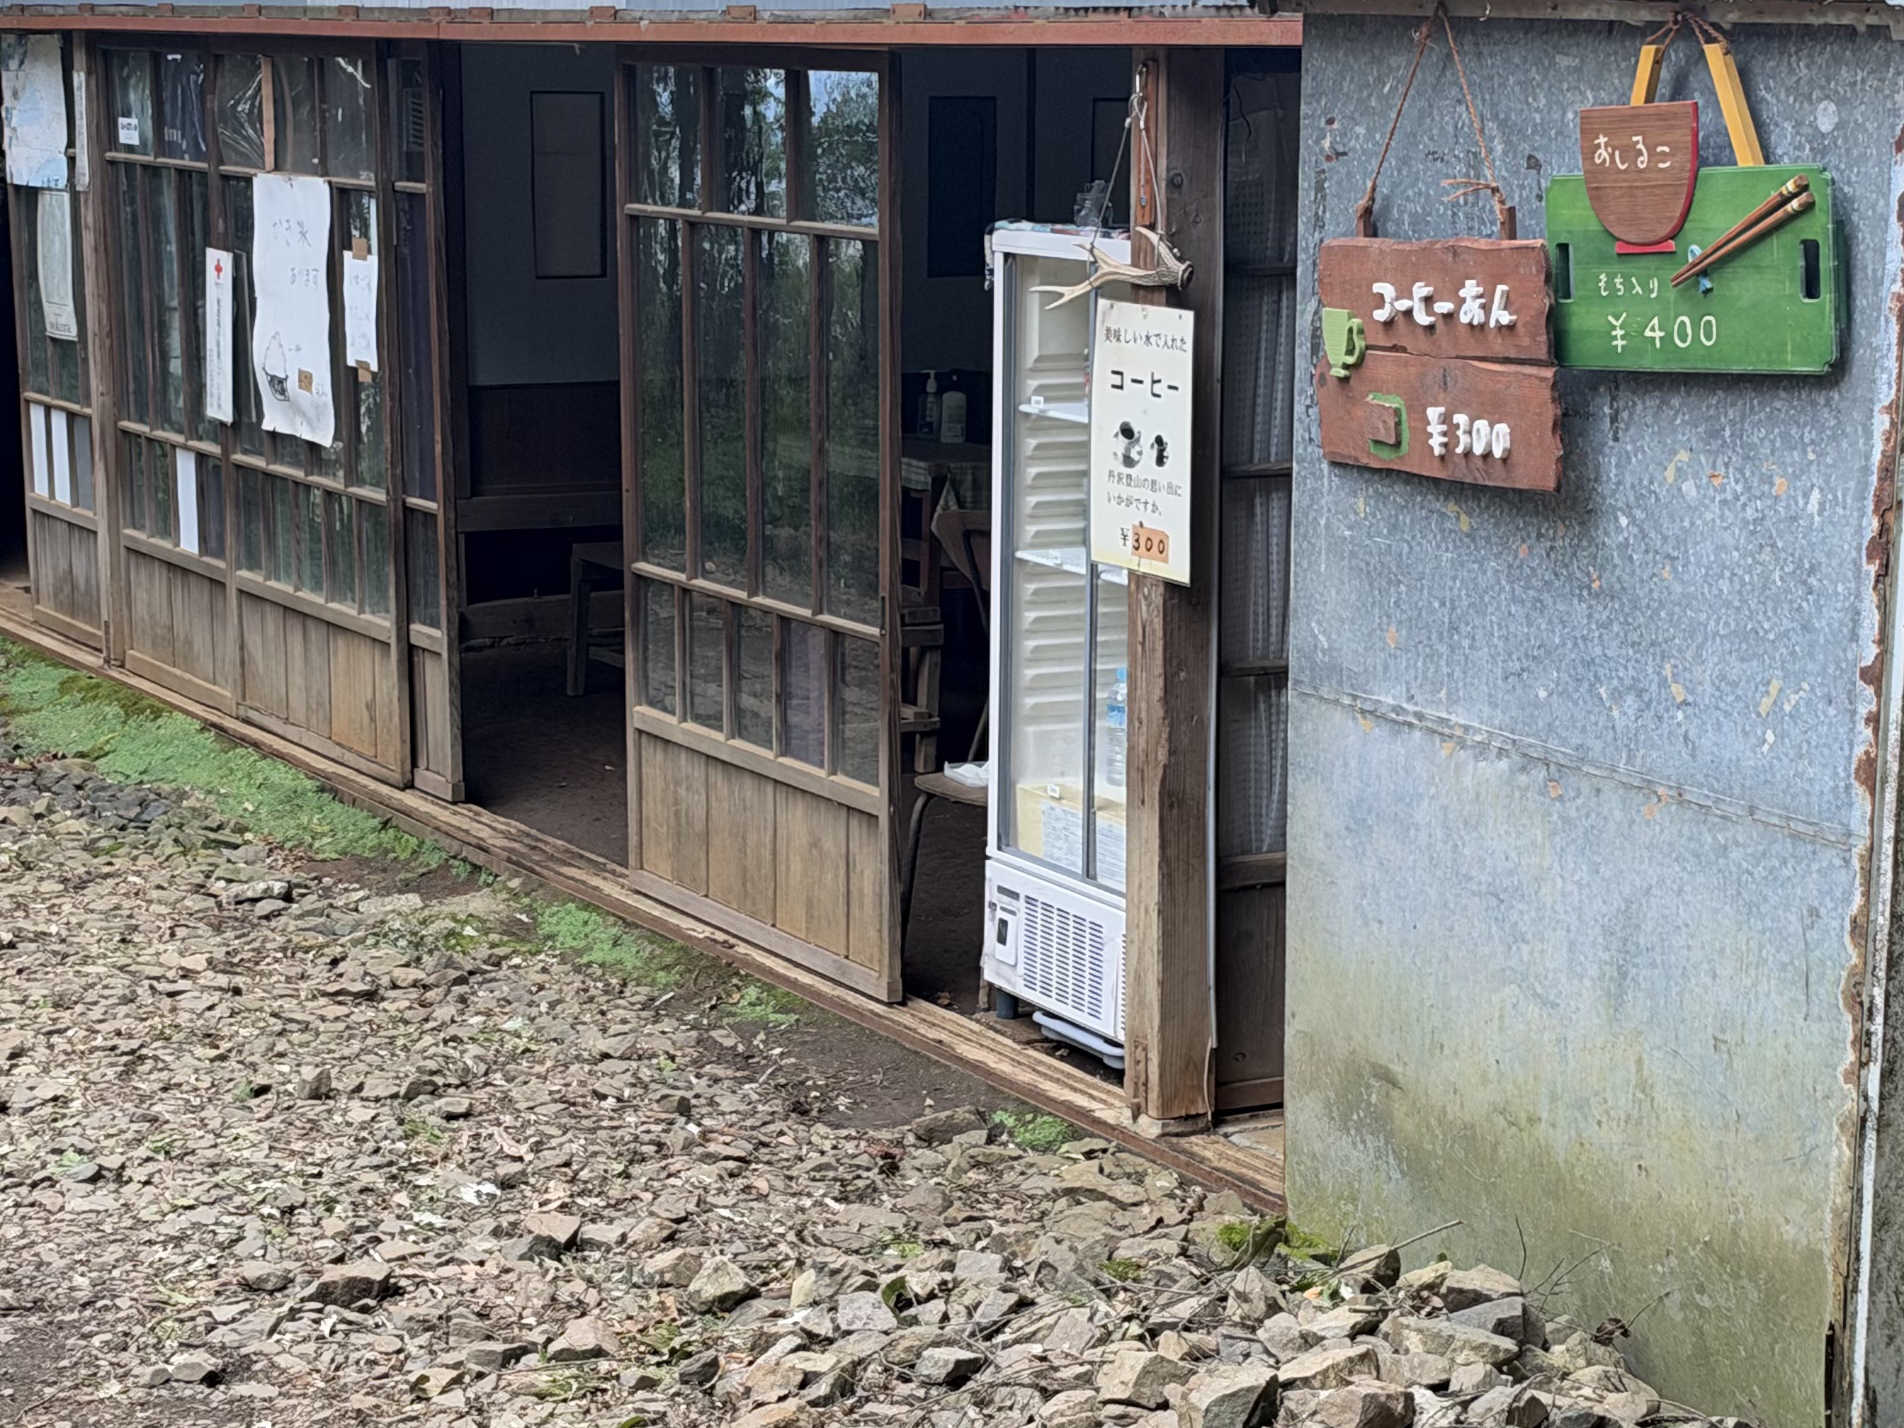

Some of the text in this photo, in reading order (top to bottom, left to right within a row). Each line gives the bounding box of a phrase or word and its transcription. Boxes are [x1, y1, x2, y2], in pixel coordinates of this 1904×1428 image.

[1594, 133, 1672, 170] おしるこ
[1598, 273, 1659, 299] もち入り
[1103, 325, 1188, 353] 美味しい水で入れた
[1607, 312, 1717, 353] ¥400
[1110, 369, 1180, 399] コーヒー
[1426, 406, 1511, 460] ¥300
[1107, 469, 1183, 498] 丹沢登山の思い出に
[1120, 527, 1166, 555] ¥300
